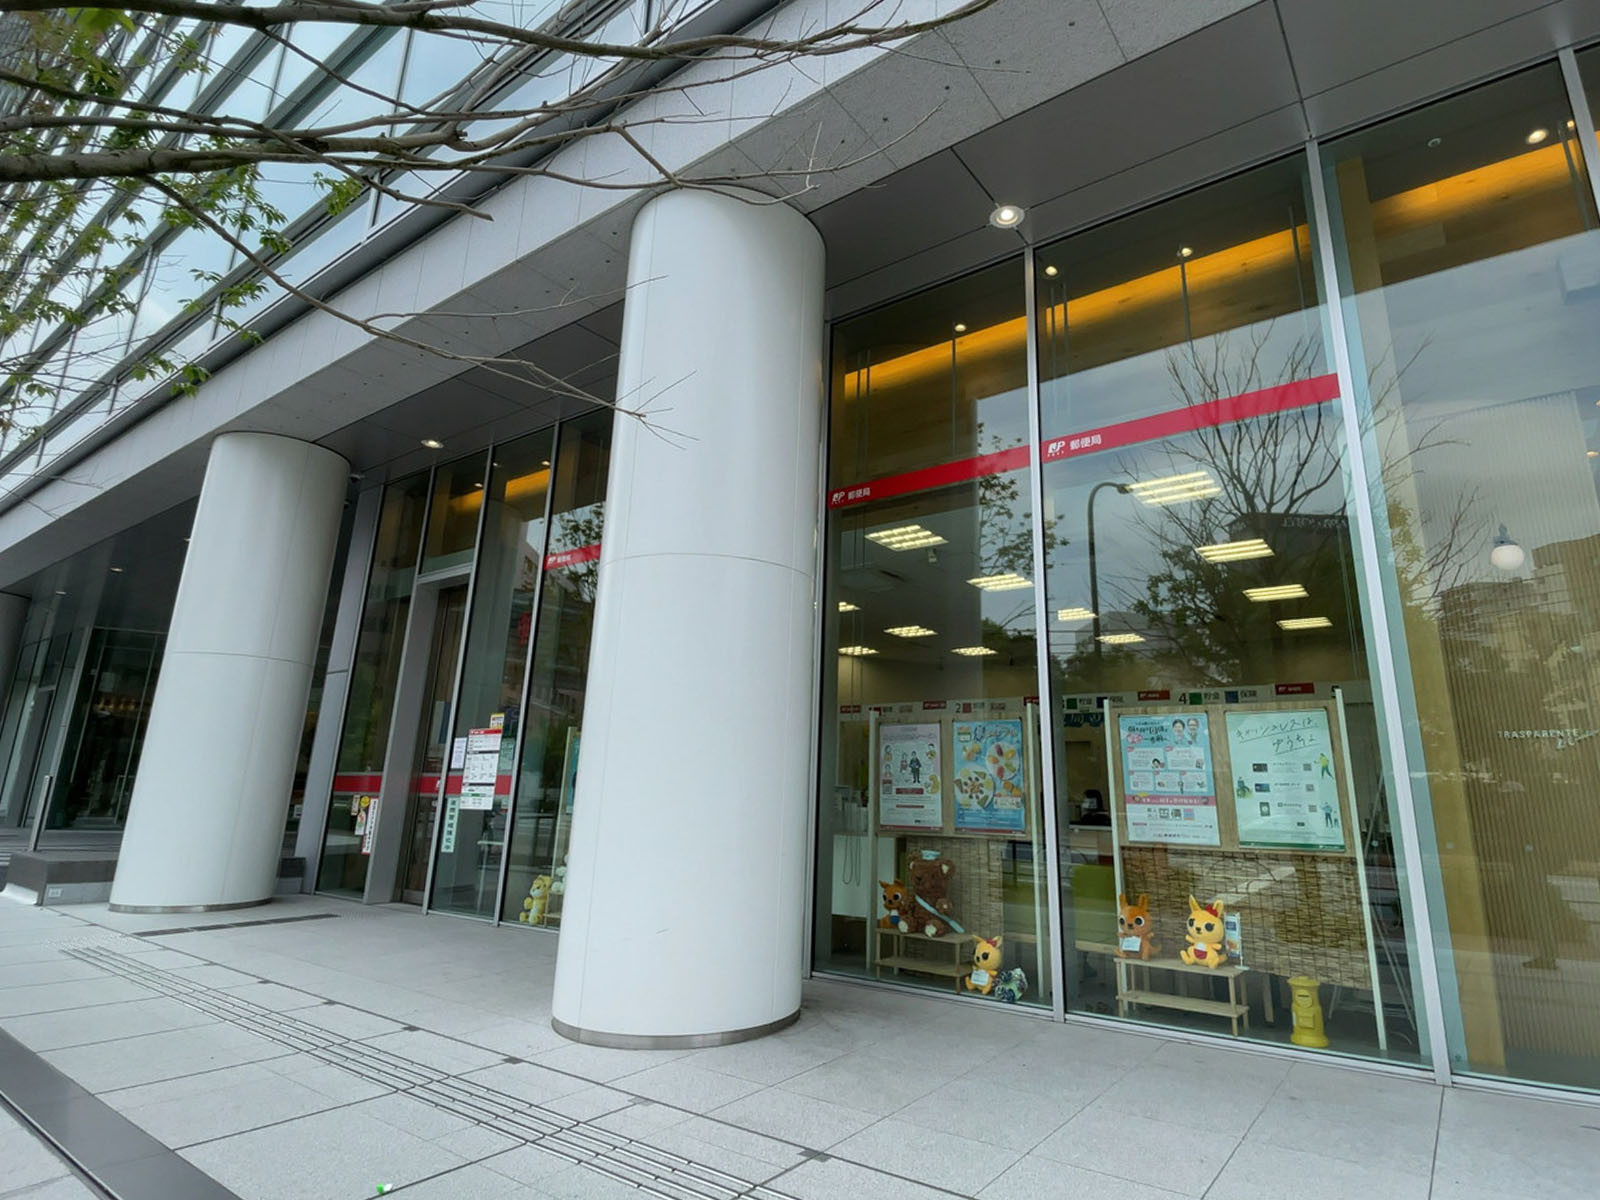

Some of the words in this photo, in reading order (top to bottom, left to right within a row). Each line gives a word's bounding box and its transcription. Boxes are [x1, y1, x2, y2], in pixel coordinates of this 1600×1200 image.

[1069, 434, 1102, 450] 郵便局
[1178, 692, 1187, 705] 4
